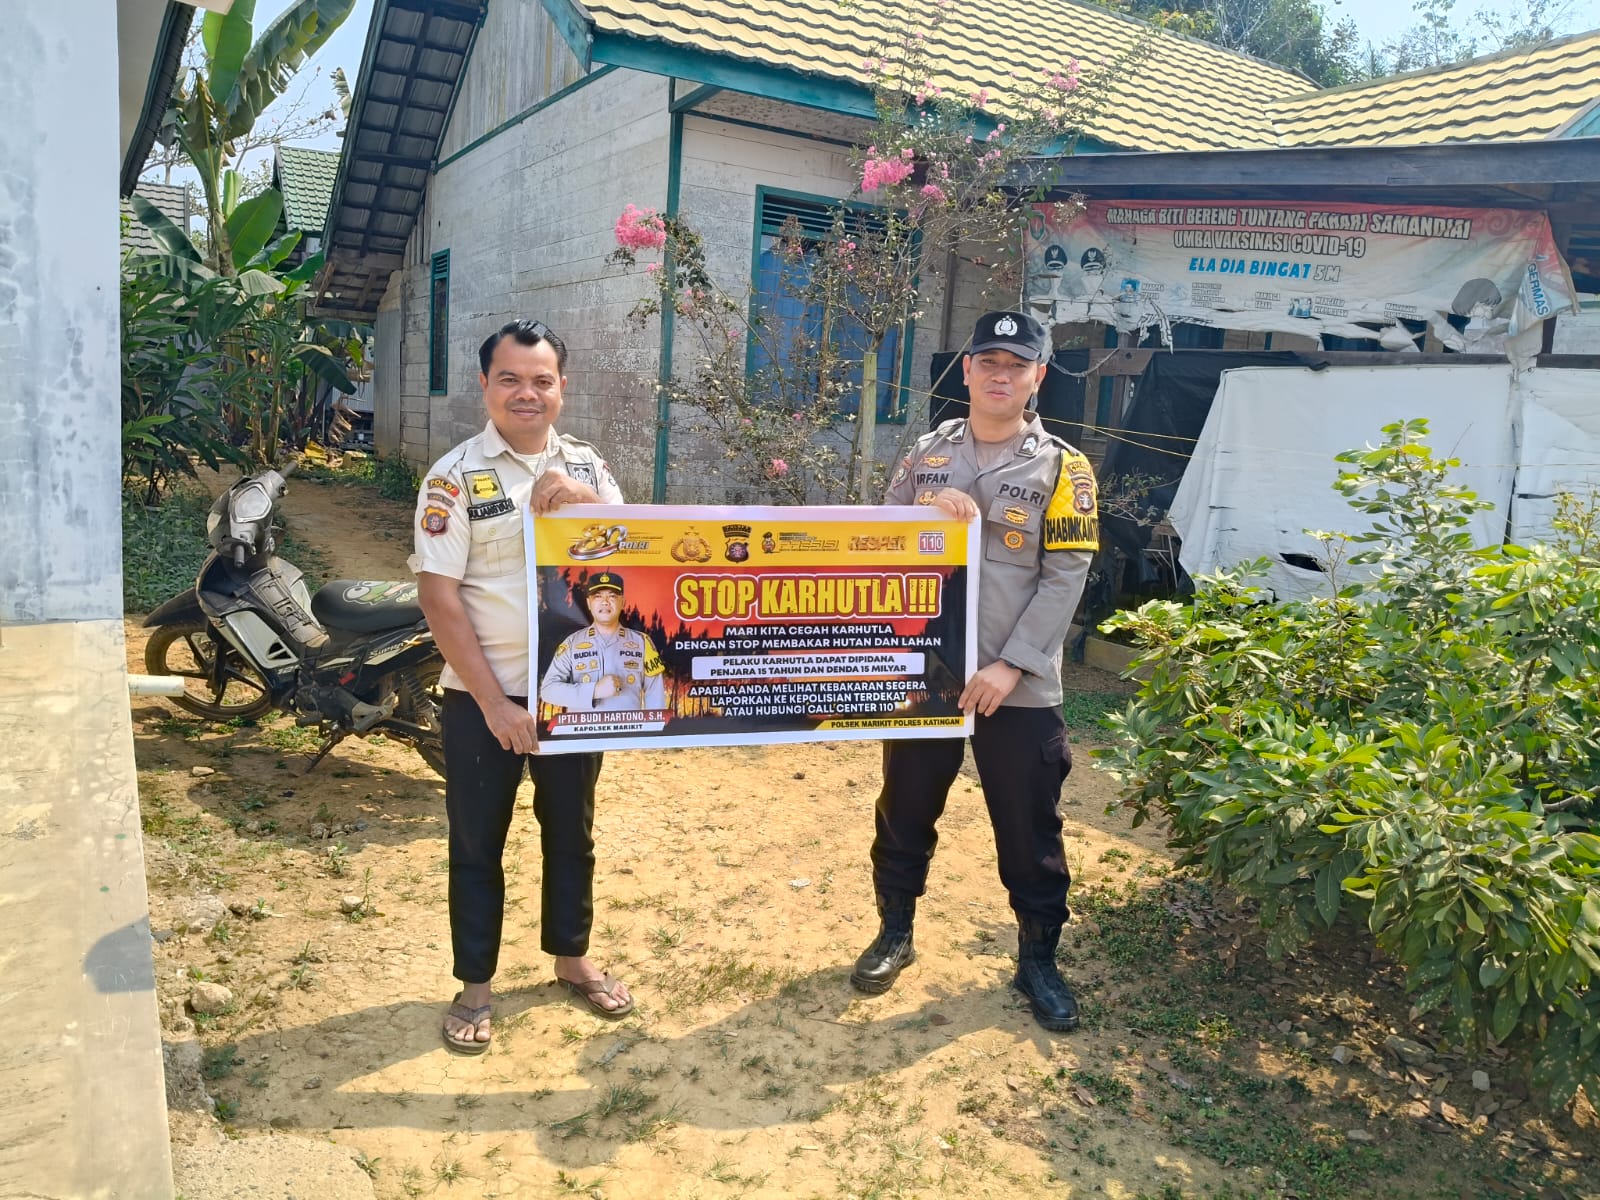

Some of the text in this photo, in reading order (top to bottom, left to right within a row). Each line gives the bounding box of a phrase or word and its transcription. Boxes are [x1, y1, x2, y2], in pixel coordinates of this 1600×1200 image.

[1158, 208, 1184, 224] BITI
[1186, 208, 1237, 225] BERENG
[1239, 208, 1306, 228] TUNTANG
[1174, 230, 1366, 258] UMBA VAKSINASI COVID-19
[1189, 257, 1341, 282] ELA DIA BINGAT 5M
[1528, 263, 1549, 316] GERMAS
[916, 473, 949, 485] IRFAN
[999, 484, 1045, 505] POLRI
[920, 535, 943, 549] 110
[680, 578, 937, 615] STOP KARHUTLA !!!
[726, 625, 892, 636] MARI KITA CEGAH KARHUTLA
[675, 637, 941, 650] DENGAN STOP MEMBAKAR HUTAN DAN LAHAN
[723, 658, 760, 666] PELAKU
[762, 657, 813, 665] KARHUTLA
[848, 655, 894, 663] DIPIDANA
[710, 668, 755, 676] PENJARA
[769, 667, 801, 675] TAHUN
[803, 666, 824, 674] DAN
[872, 664, 906, 672] MILYAR
[690, 681, 926, 696] APABILA ANDA MELIHAT KEBAKARAN SEGERA
[712, 691, 906, 706] LAPORKAN KE KEPOLISIAN TERDEKAT
[725, 702, 894, 716] ATAU HUBUNGI CALL CENTER 110
[558, 711, 665, 724] IPTU BUDI HARTONO, S.H.
[923, 718, 960, 726] KATINGAN
